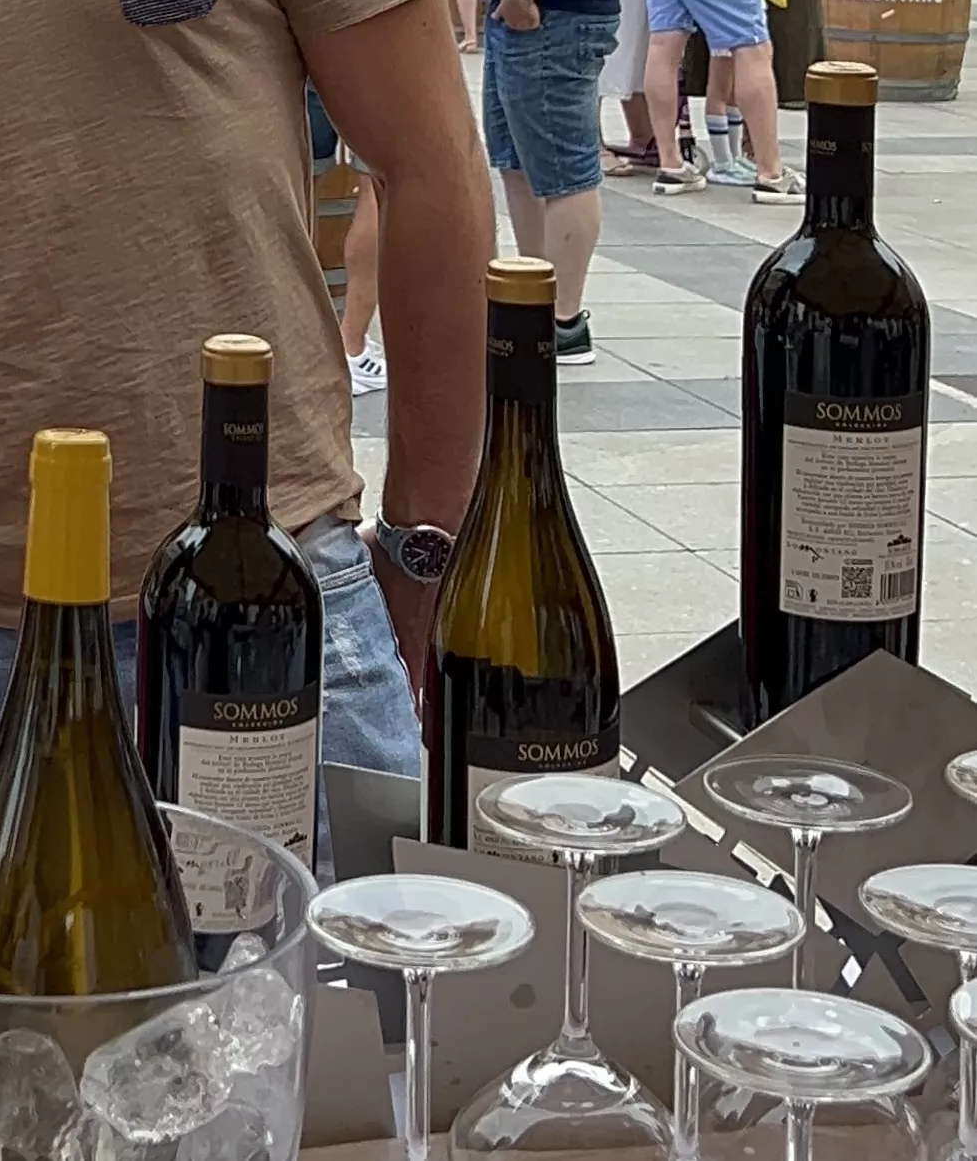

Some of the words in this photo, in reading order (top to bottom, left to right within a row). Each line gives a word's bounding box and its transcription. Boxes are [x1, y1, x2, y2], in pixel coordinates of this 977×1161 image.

[815, 401, 902, 422] SOMMOS
[213, 696, 299, 721] SOMMOS
[517, 738, 600, 762] SOMMOS
